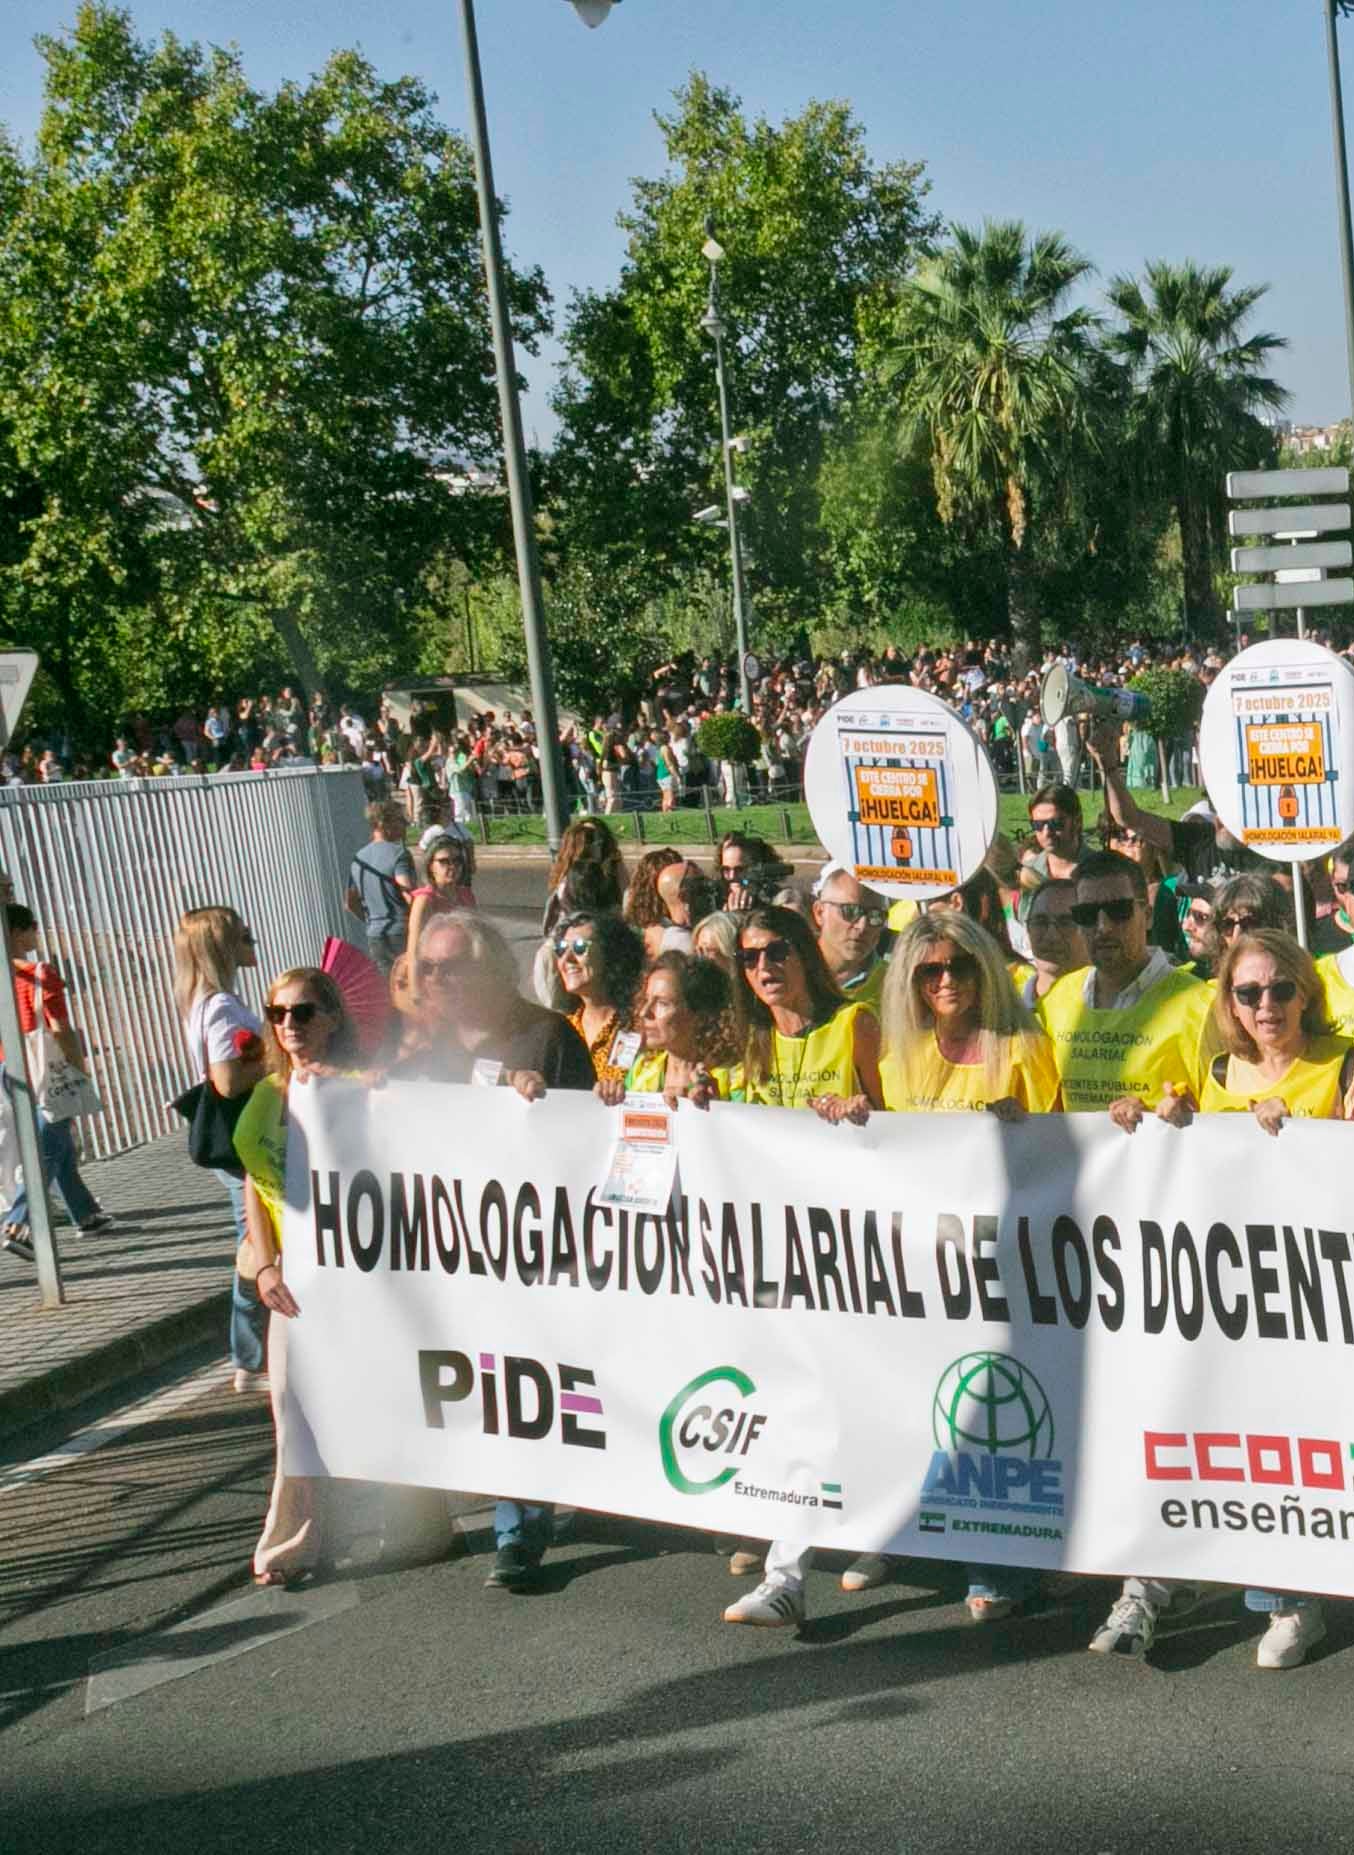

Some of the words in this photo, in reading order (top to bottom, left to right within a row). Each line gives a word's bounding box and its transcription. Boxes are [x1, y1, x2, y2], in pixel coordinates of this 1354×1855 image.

[1251, 757, 1323, 780] ¡HUELGA!
[861, 799, 938, 822] ¡HUELGA!
[699, 1198, 927, 1319] SALARIAL
[936, 1213, 1011, 1322] DE
[1017, 1214, 1126, 1332] LOS
[679, 1404, 768, 1456] CSIF
[920, 1450, 1064, 1503] ANPE
[1143, 1430, 1346, 1491] CCOO
[734, 1481, 818, 1507] Extremadura
[952, 1519, 1064, 1541] EXTREMADURA
